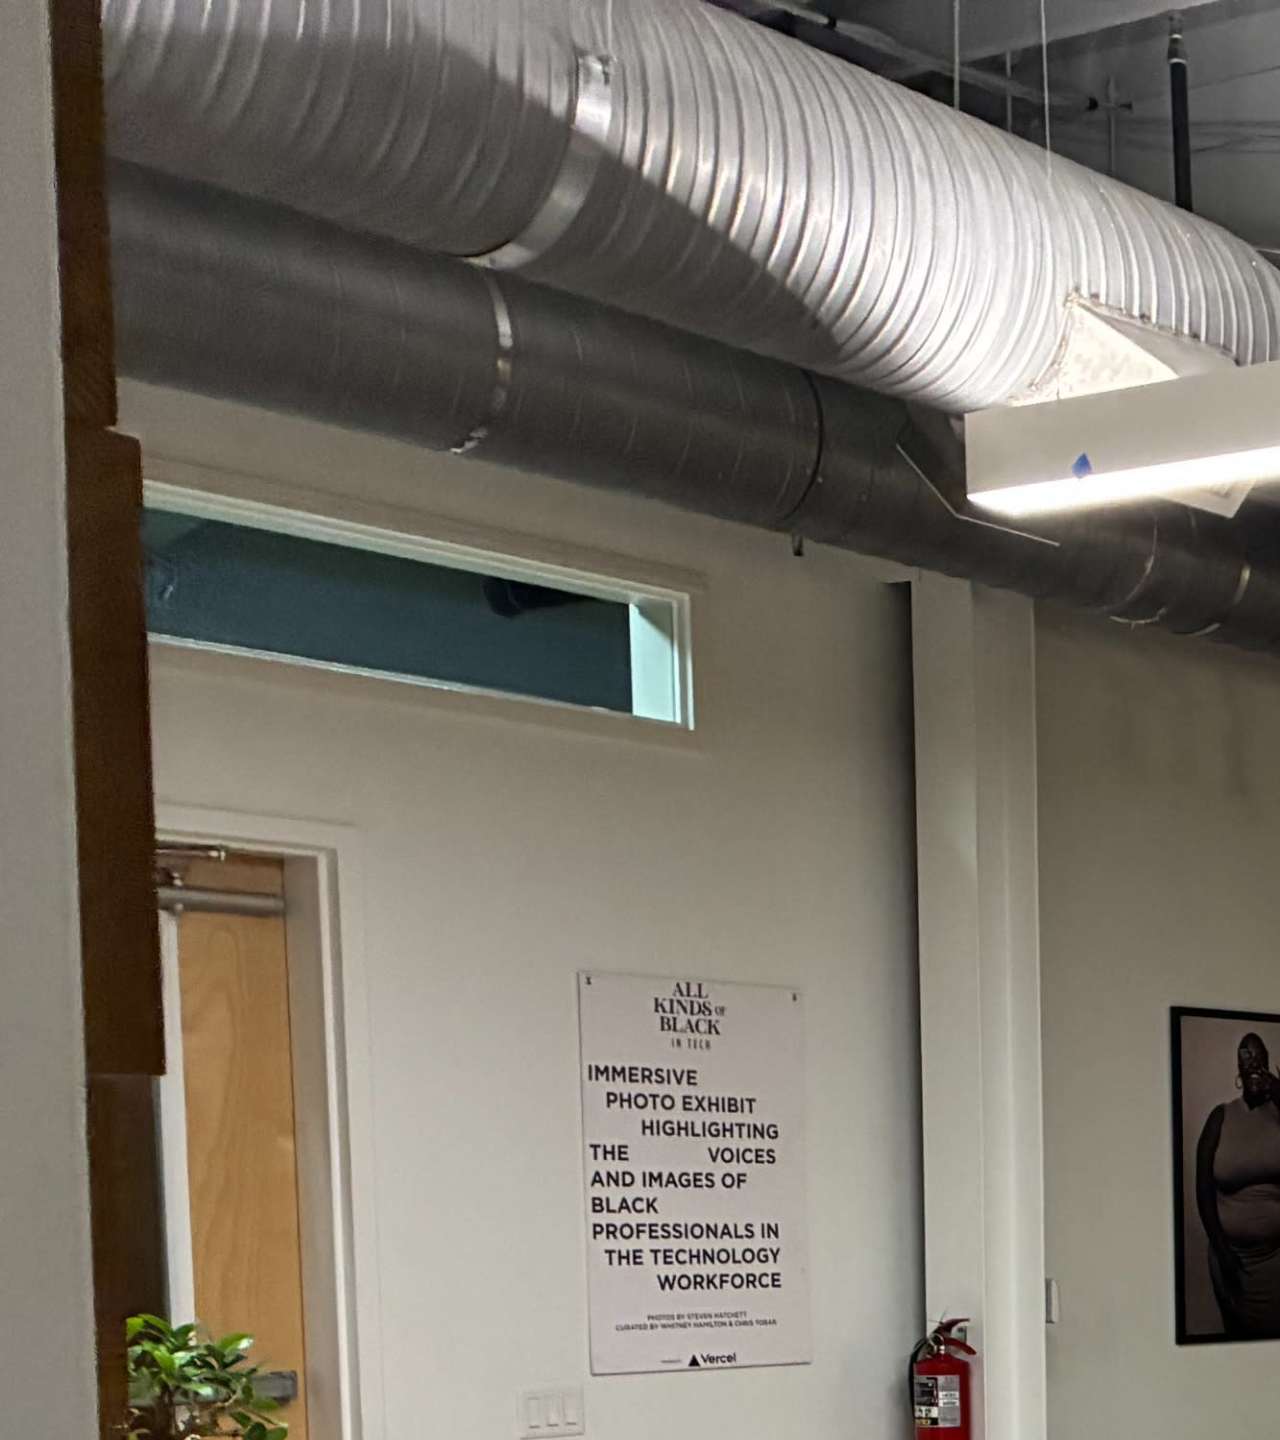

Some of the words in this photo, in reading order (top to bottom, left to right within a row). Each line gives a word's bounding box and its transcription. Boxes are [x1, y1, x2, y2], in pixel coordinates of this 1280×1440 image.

[672, 981, 709, 999] ALL
[654, 997, 712, 1016] KINDS
[714, 1005, 725, 1016] OF
[660, 1015, 721, 1035] BLACK
[671, 1037, 681, 1049] IN
[687, 1037, 711, 1051] TECH
[588, 1064, 698, 1087] IMMERSIVE
[606, 1091, 676, 1111] PHOTO
[681, 1095, 757, 1115] EXHIBIT
[641, 1119, 779, 1140] HIGHLIGHTING
[589, 1143, 630, 1162] THE
[707, 1146, 777, 1165] VOICES
[590, 1170, 636, 1188] AND
[641, 1171, 716, 1189] IMAGES
[720, 1172, 747, 1190] OF
[591, 1196, 659, 1214] BLACK
[592, 1222, 755, 1240] PROFESSIONALS
[761, 1222, 779, 1239] IN
[604, 1248, 644, 1266] THE
[649, 1247, 781, 1266] TECHNOLOGY
[656, 1272, 782, 1291] WORKFORCE
[700, 1352, 736, 1363] Vercel
